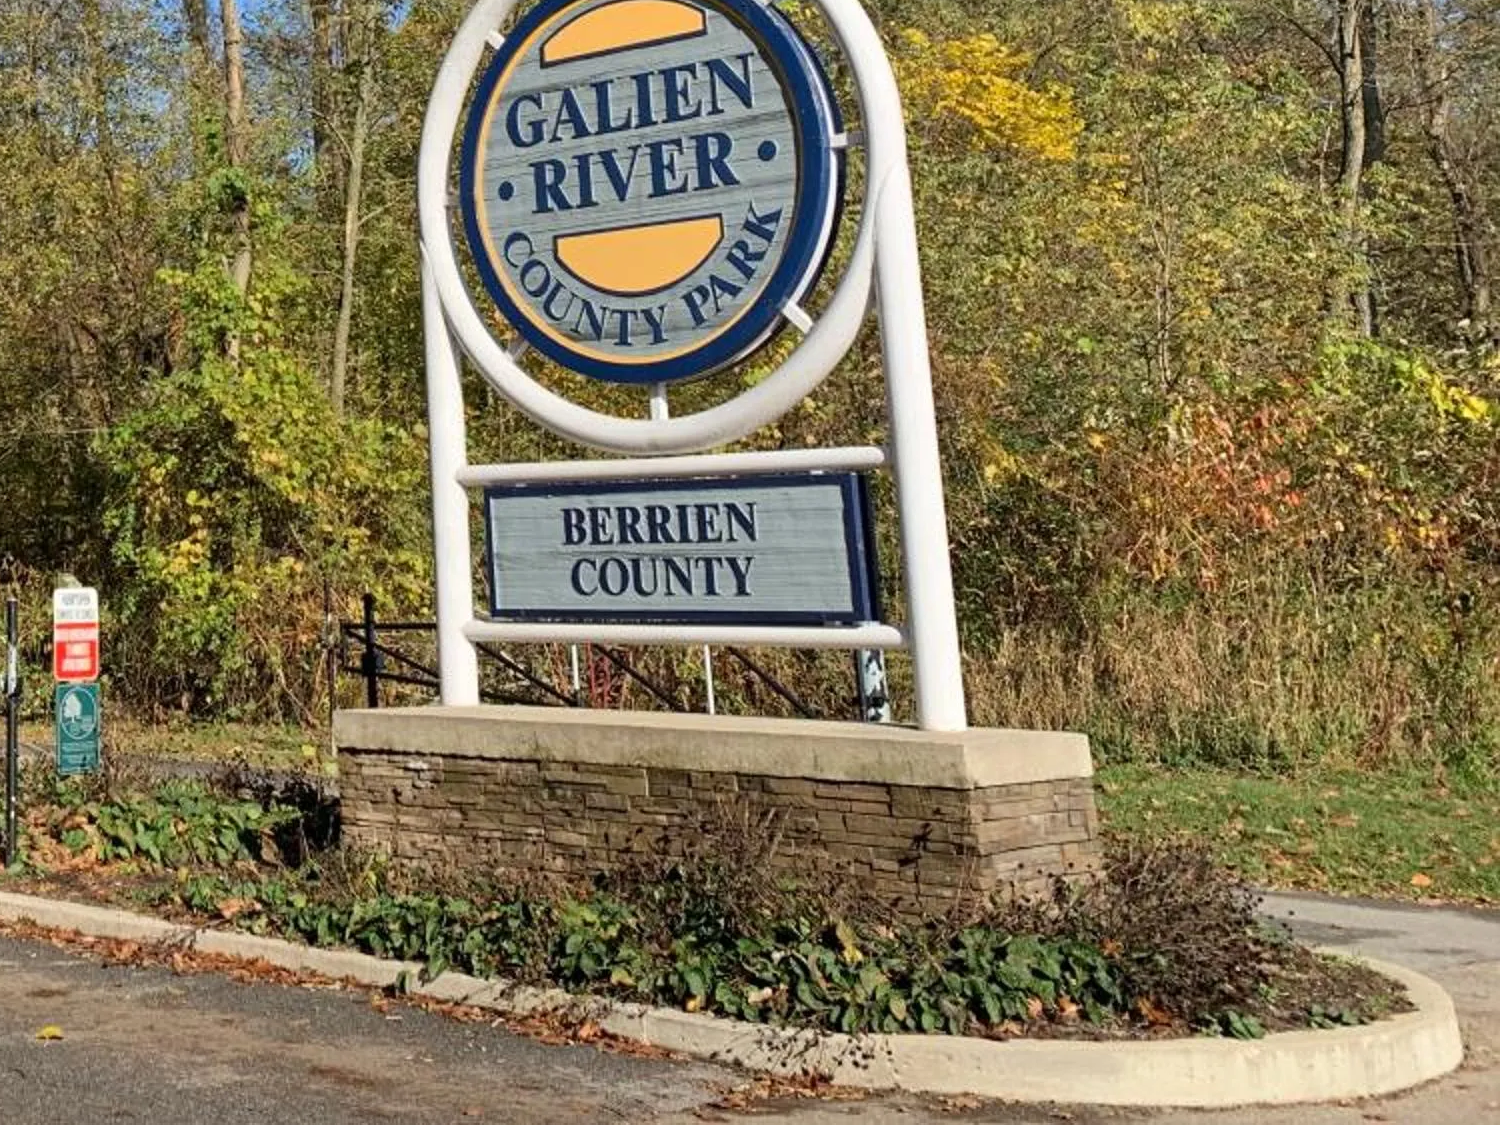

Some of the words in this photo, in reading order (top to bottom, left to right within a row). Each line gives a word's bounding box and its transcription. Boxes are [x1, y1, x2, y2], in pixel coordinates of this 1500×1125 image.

[505, 52, 756, 148] GALIEN
[529, 131, 740, 214] RIVER
[503, 231, 669, 346] COUNTY
[680, 201, 784, 326] PARK
[561, 502, 757, 546] BERRIEN
[571, 555, 756, 597] COUNTY
